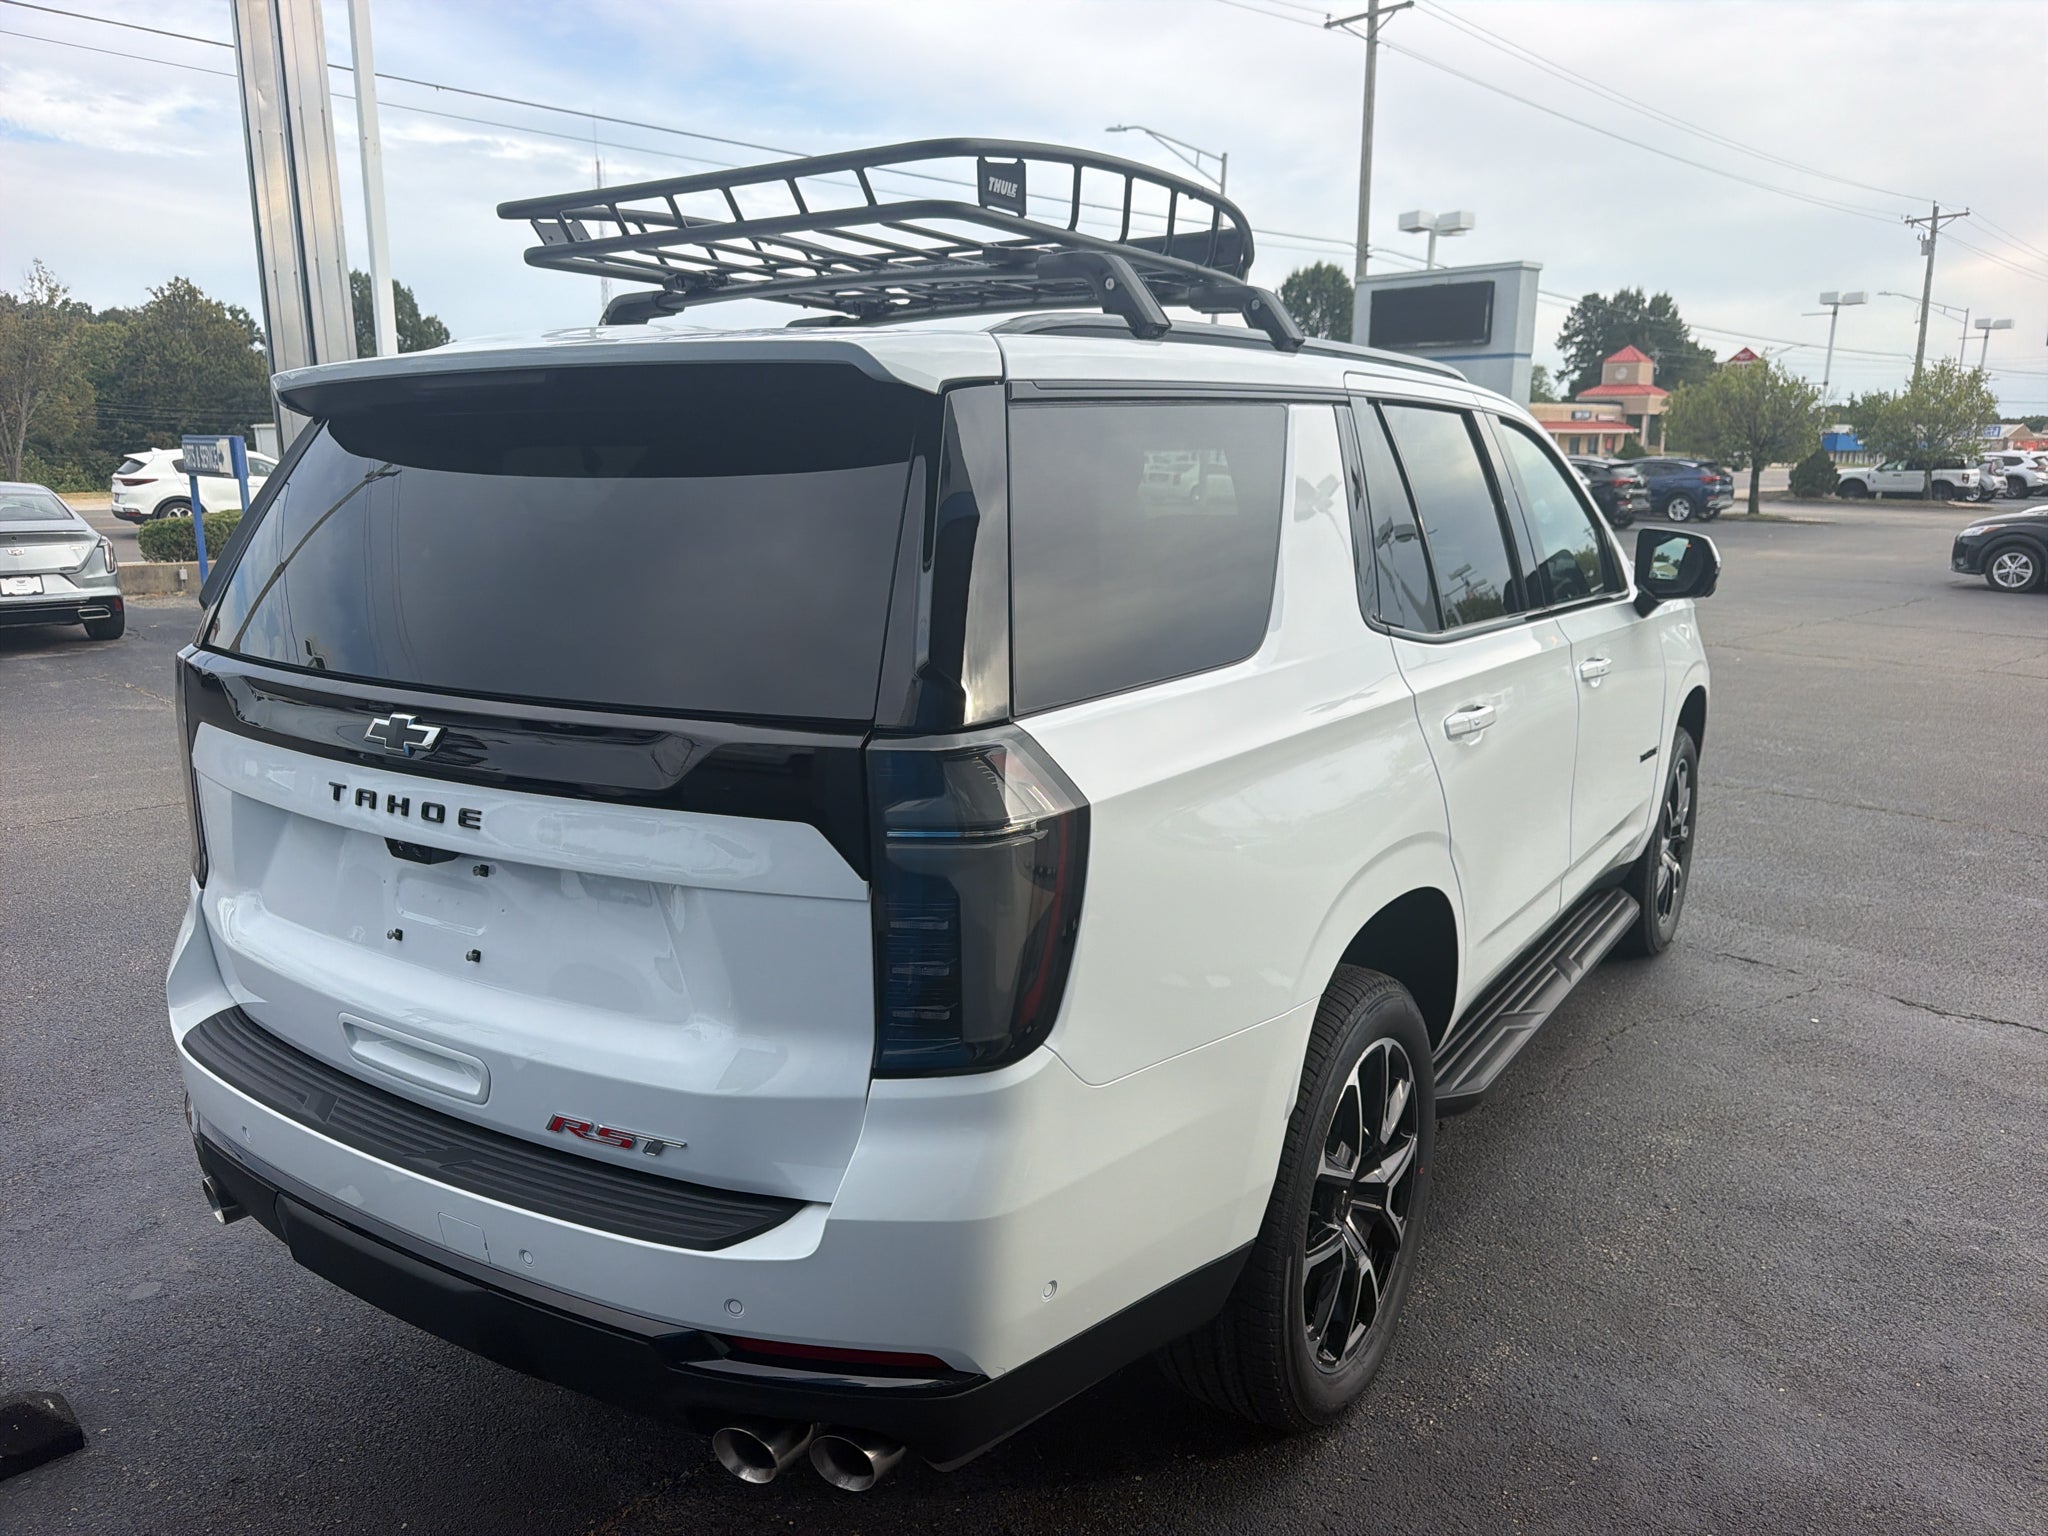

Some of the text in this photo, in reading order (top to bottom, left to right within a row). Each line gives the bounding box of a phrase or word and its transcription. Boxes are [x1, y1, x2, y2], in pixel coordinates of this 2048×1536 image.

[988, 176, 1018, 198] THULE
[329, 781, 482, 830] TAHOE
[546, 1111, 687, 1156] RST
